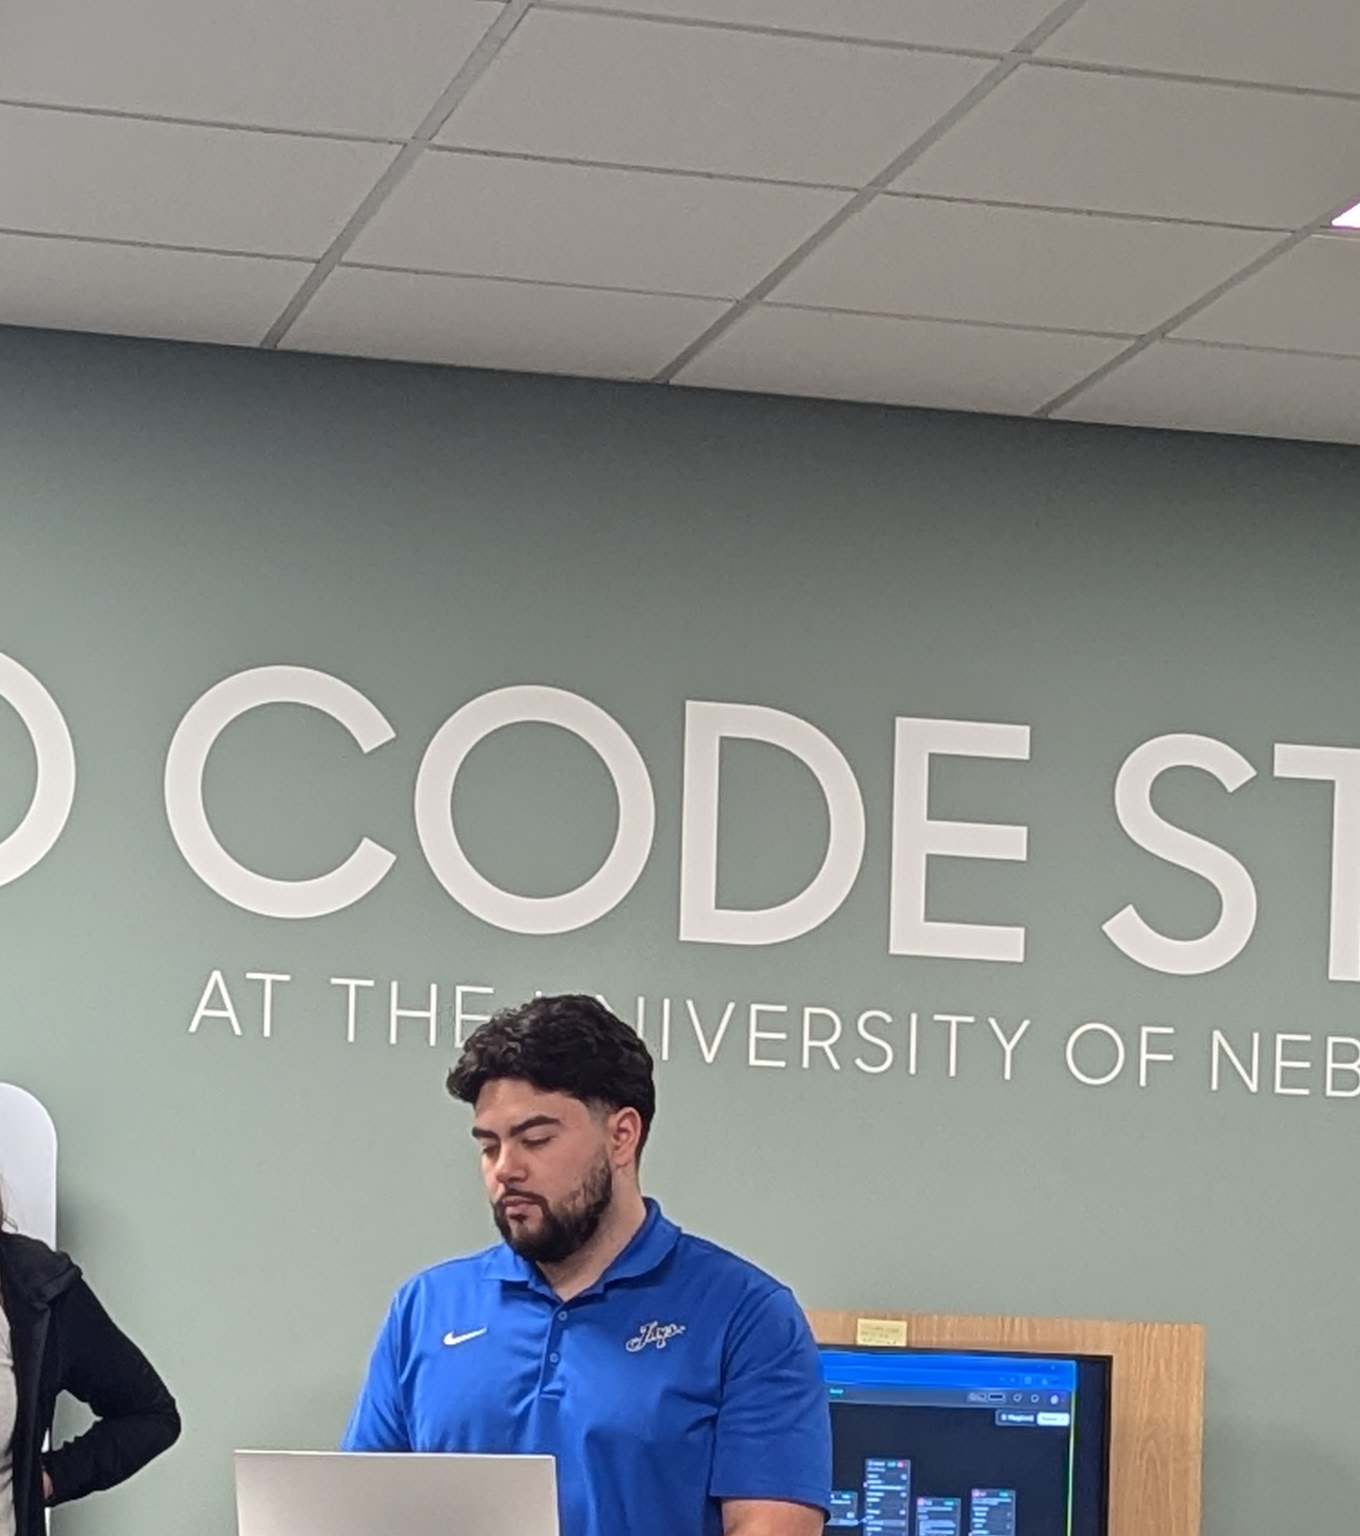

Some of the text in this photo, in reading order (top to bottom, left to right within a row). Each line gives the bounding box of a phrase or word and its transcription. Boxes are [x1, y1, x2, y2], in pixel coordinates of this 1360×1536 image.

[163, 663, 1032, 964] CODE
[188, 969, 291, 1038] AT
[330, 977, 495, 1049] THE
[533, 990, 1031, 1081] IVERSITY
[1065, 1022, 1175, 1087] OF
